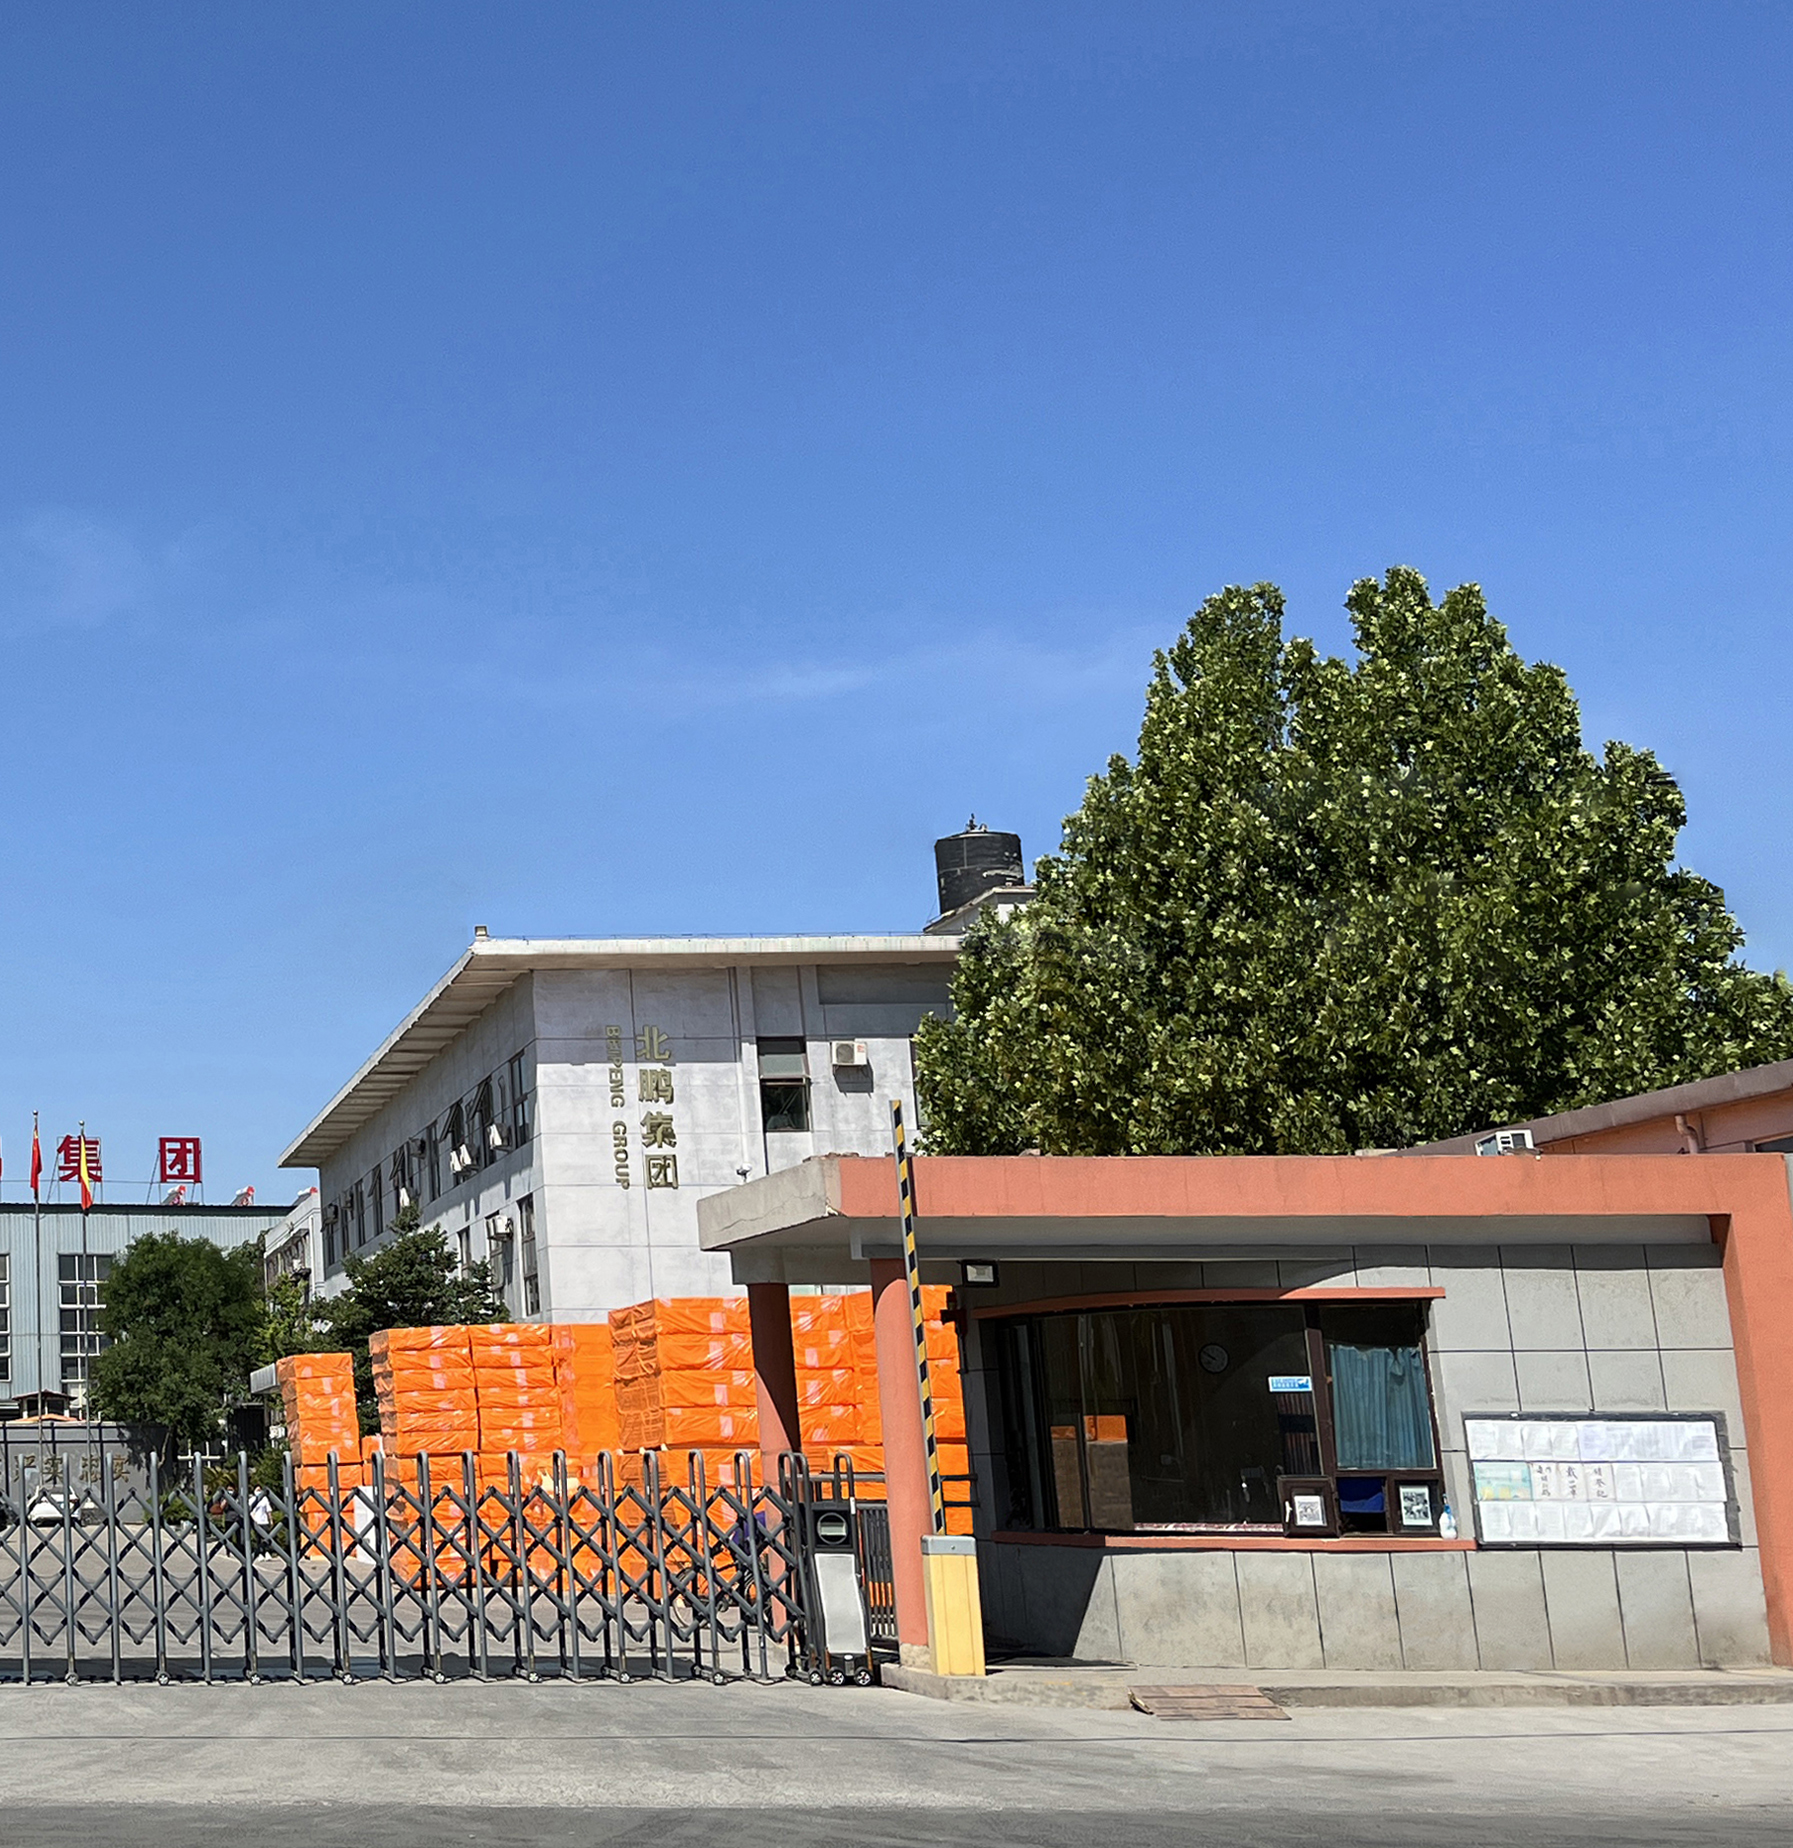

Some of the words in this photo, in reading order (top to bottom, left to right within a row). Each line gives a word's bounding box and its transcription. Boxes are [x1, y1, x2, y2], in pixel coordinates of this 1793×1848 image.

[606, 1025, 626, 1108] BEIPENG
[635, 1025, 679, 1190] 北鹏集团
[612, 1120, 630, 1190] GROUP
